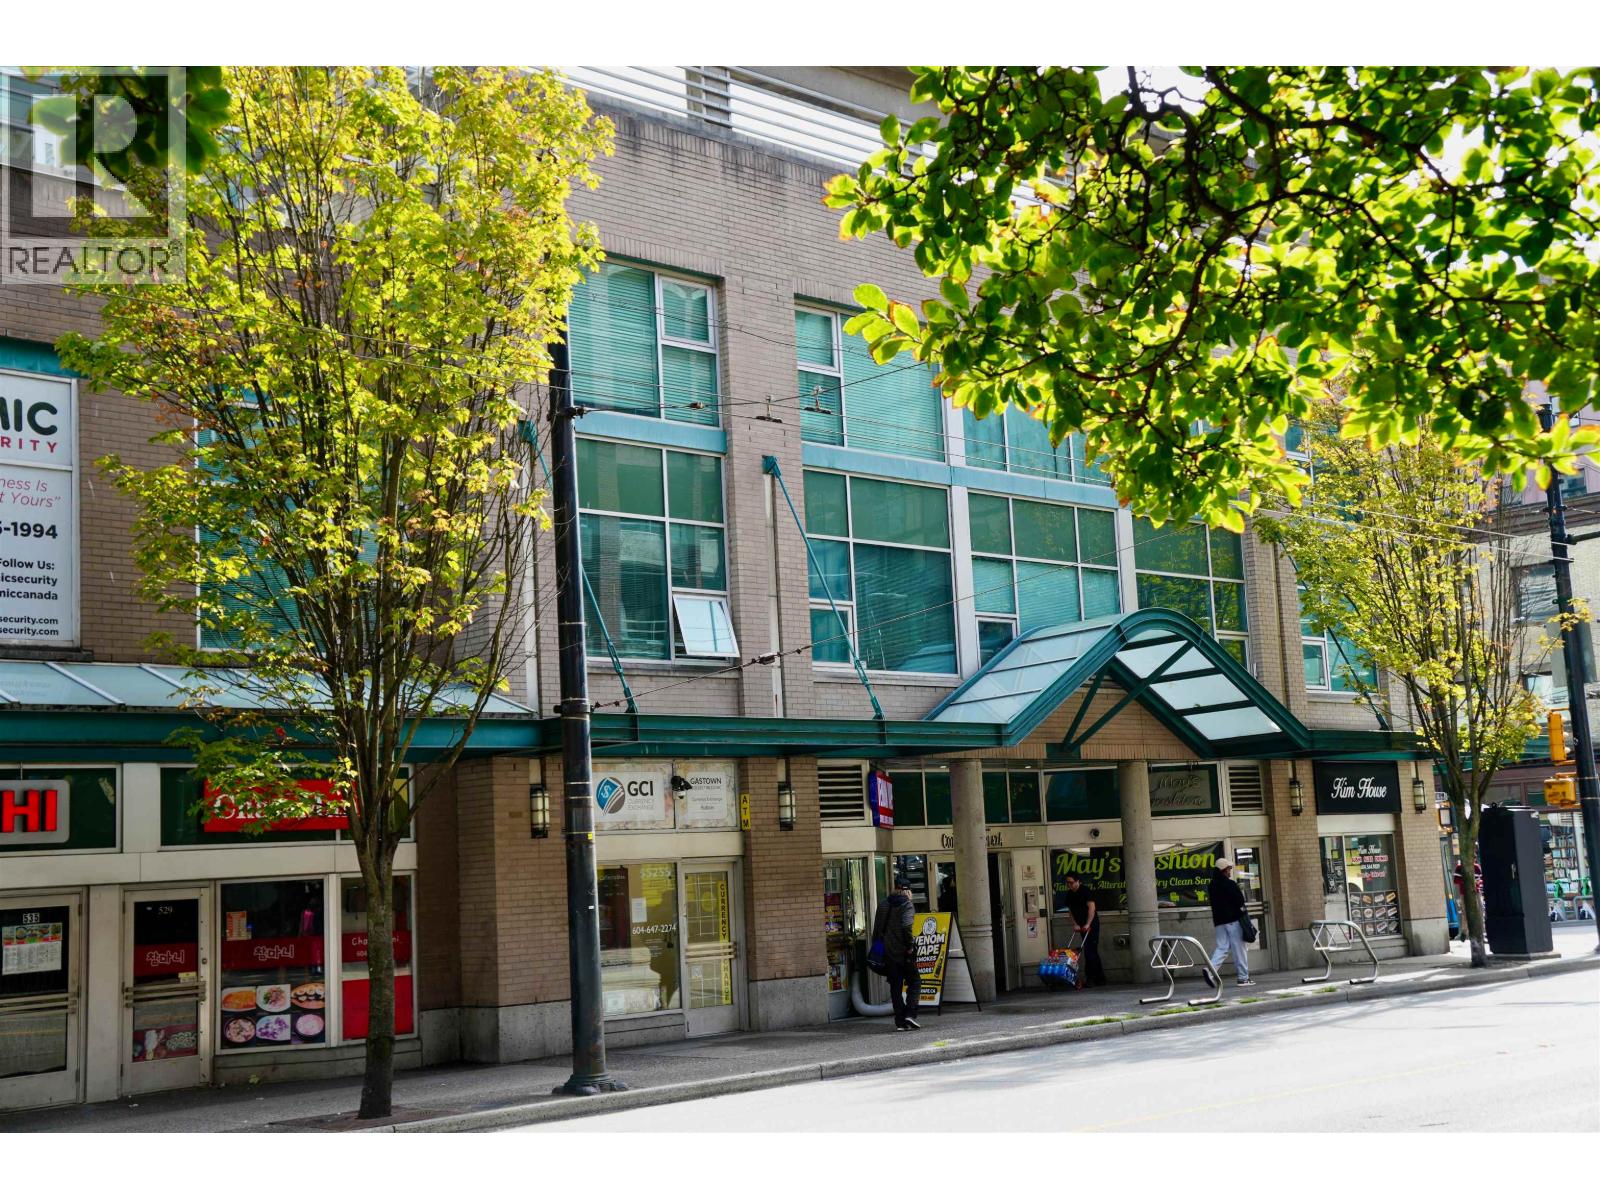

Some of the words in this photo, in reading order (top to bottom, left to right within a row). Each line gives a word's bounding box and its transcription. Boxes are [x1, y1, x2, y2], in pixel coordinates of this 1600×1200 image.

[36, 479, 48, 493] Is
[37, 560, 55, 570] Us:
[690, 777, 722, 785] GASTOWN
[1331, 777, 1356, 799] Kim
[1357, 777, 1388, 799] House
[627, 780, 654, 797] GCI
[2, 788, 57, 833] HI
[742, 795, 750, 828] ATM
[1056, 851, 1121, 880] May's
[1169, 877, 1193, 887] Clean
[158, 906, 173, 915] 529
[23, 913, 40, 924] 535
